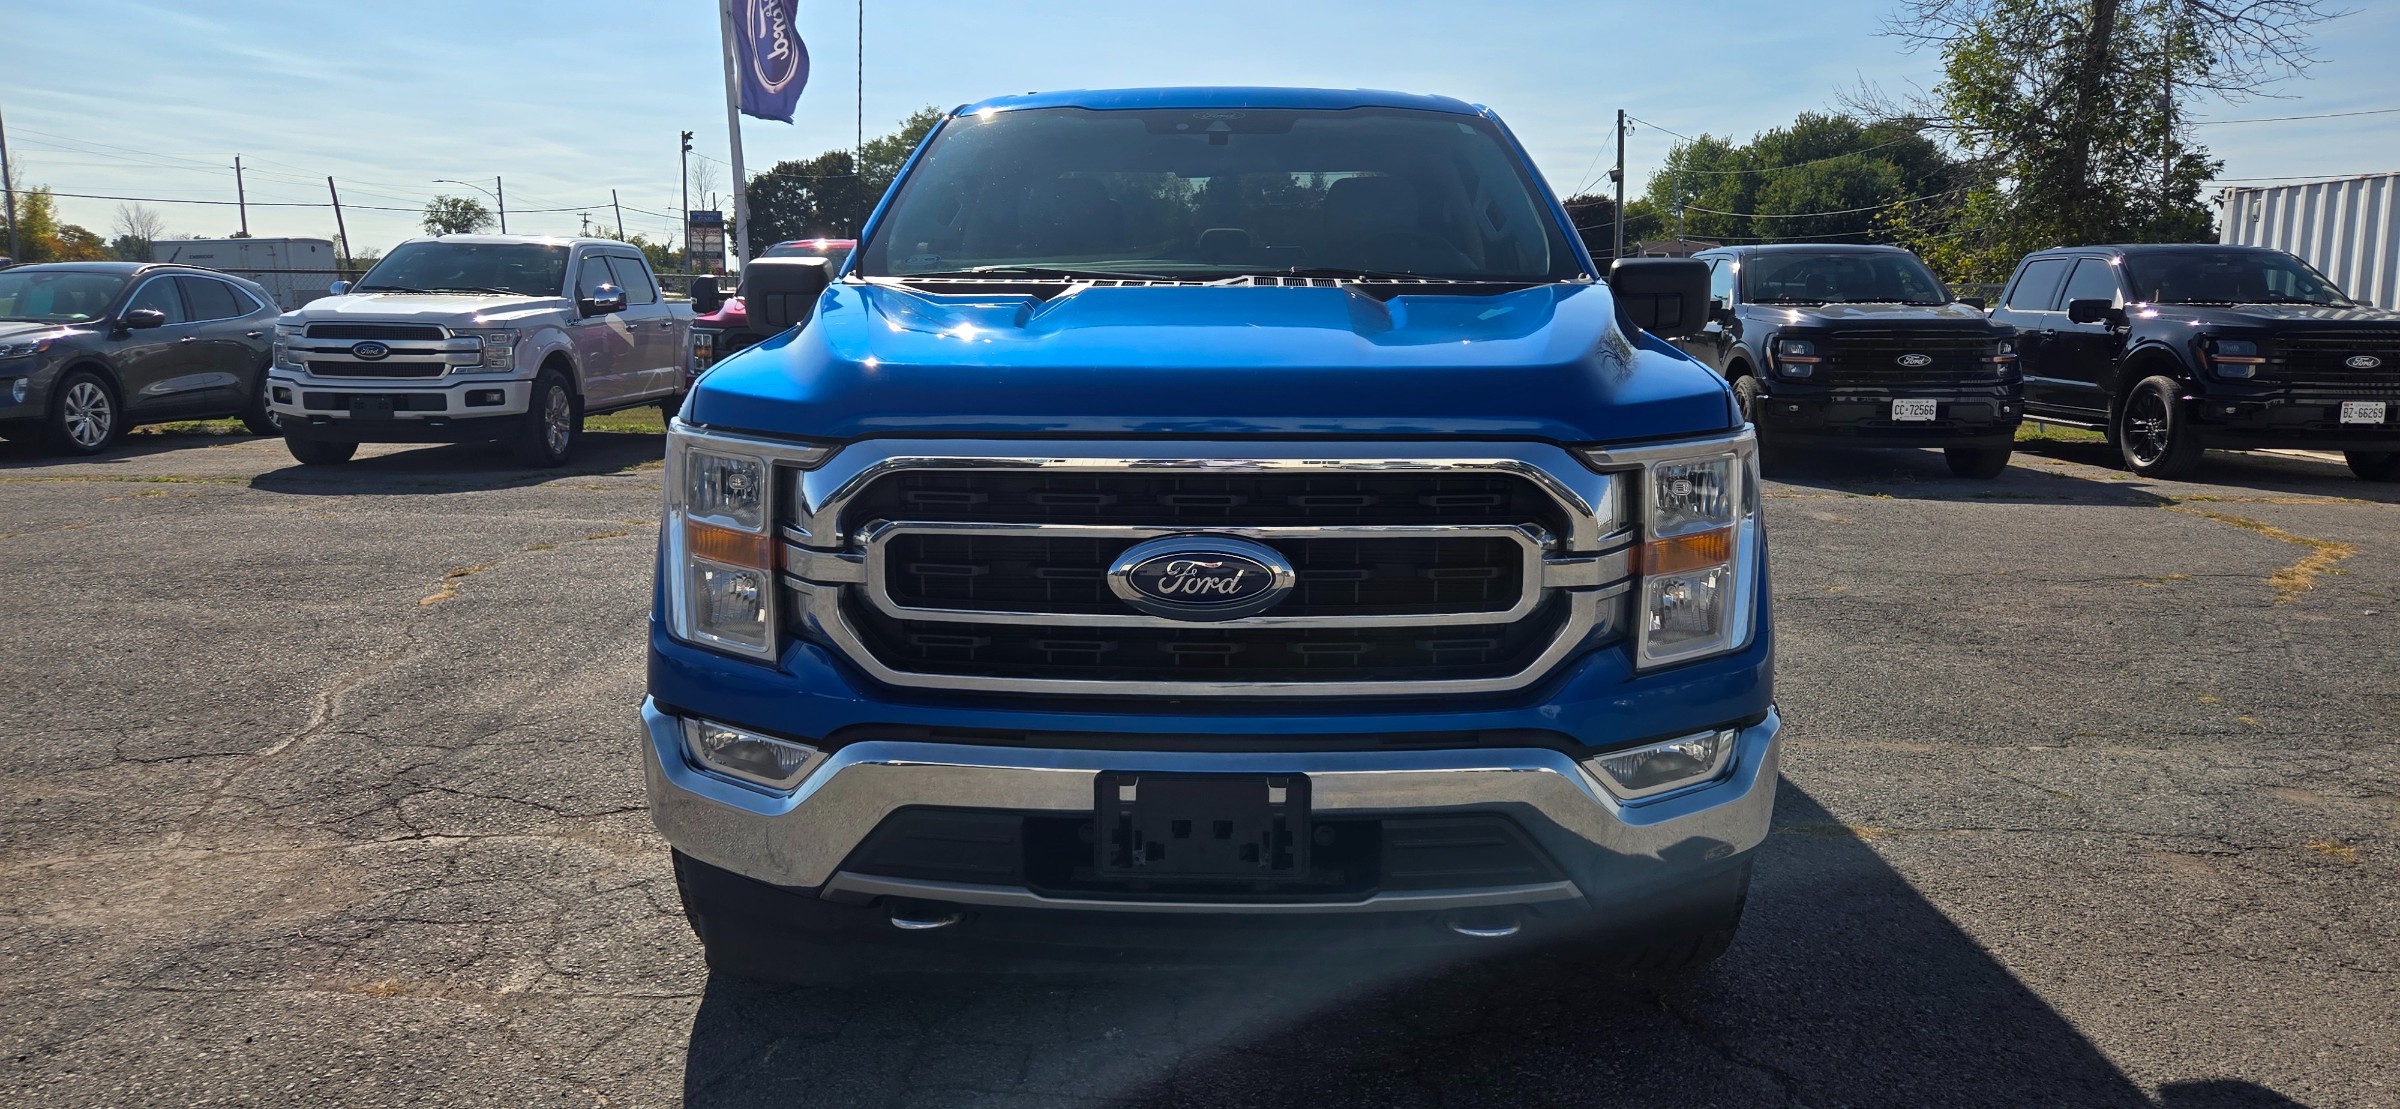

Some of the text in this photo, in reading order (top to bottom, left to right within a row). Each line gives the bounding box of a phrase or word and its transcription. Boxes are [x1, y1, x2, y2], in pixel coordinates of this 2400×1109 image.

[361, 346, 379, 354] Ford
[1903, 356, 1925, 365] Ford
[2352, 357, 2375, 366] Ford
[1157, 559, 1245, 595] Ford
